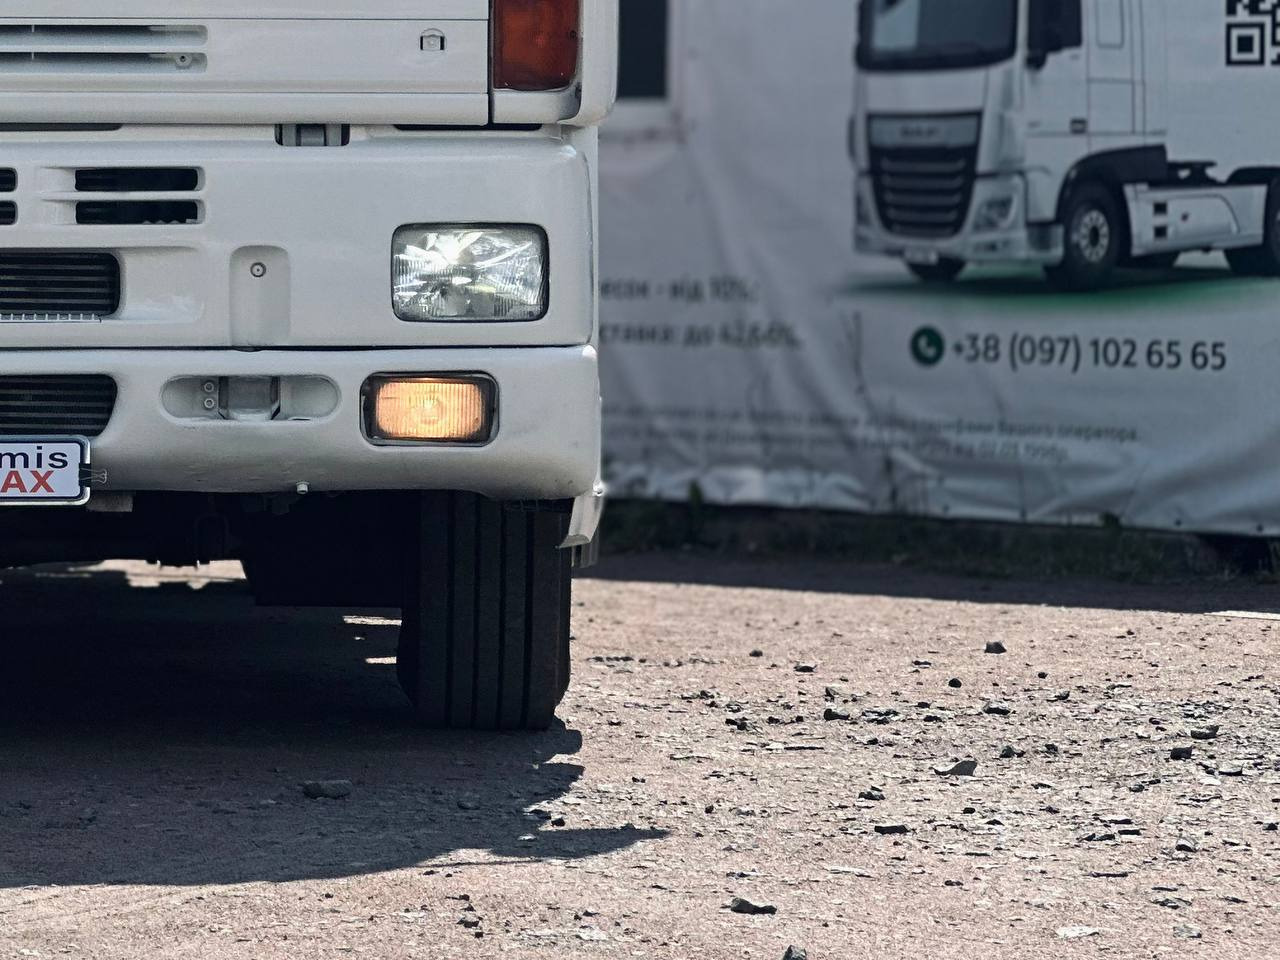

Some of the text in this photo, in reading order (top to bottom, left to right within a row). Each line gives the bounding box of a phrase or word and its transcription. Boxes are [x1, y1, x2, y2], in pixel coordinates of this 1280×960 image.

[952, 333, 1227, 375] +38 (097) 102 65 65
